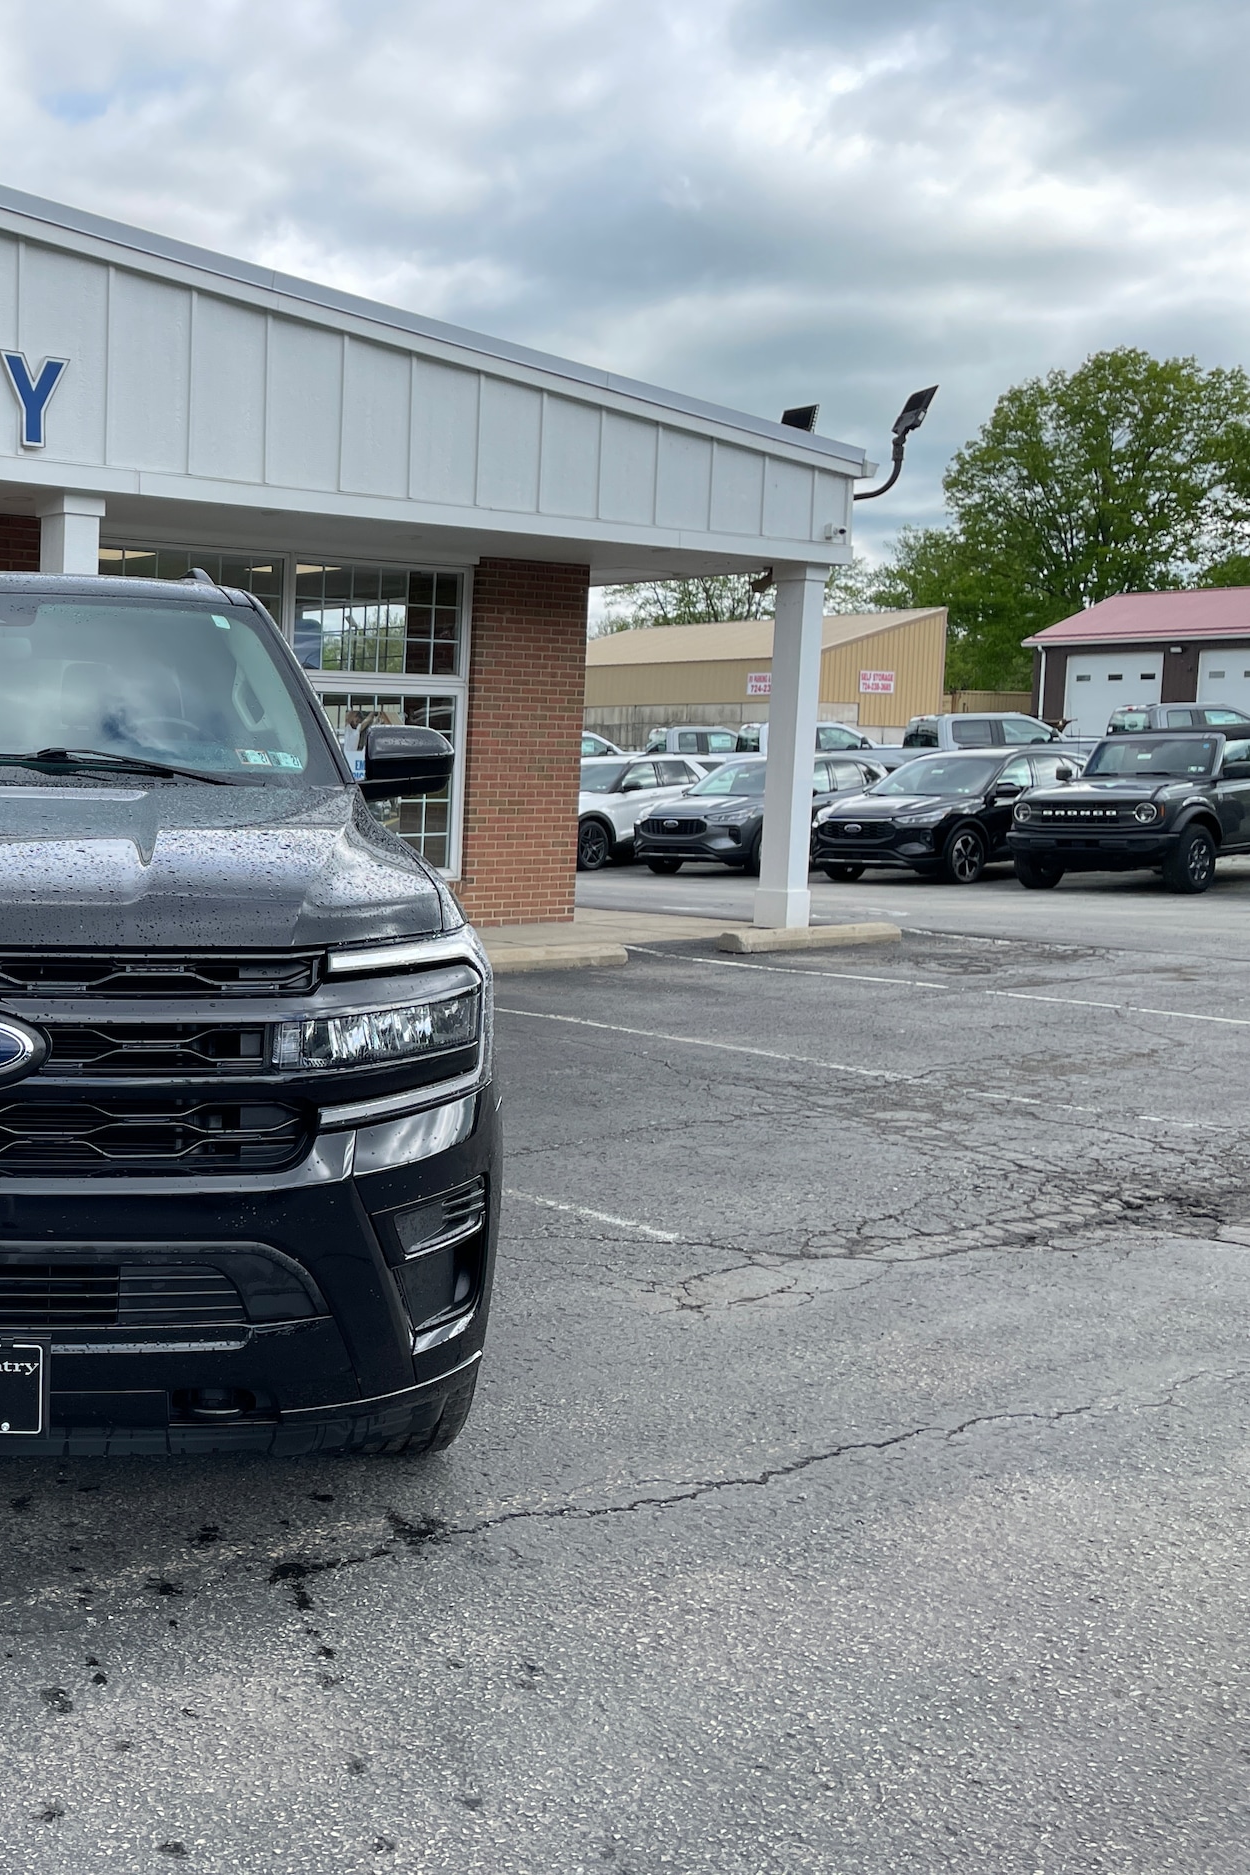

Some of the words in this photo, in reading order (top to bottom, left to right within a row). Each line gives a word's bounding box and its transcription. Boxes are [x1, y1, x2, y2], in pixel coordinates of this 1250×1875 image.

[861, 672, 872, 681] SELF
[873, 672, 894, 682] STORAGE
[751, 684, 771, 693] 724-23
